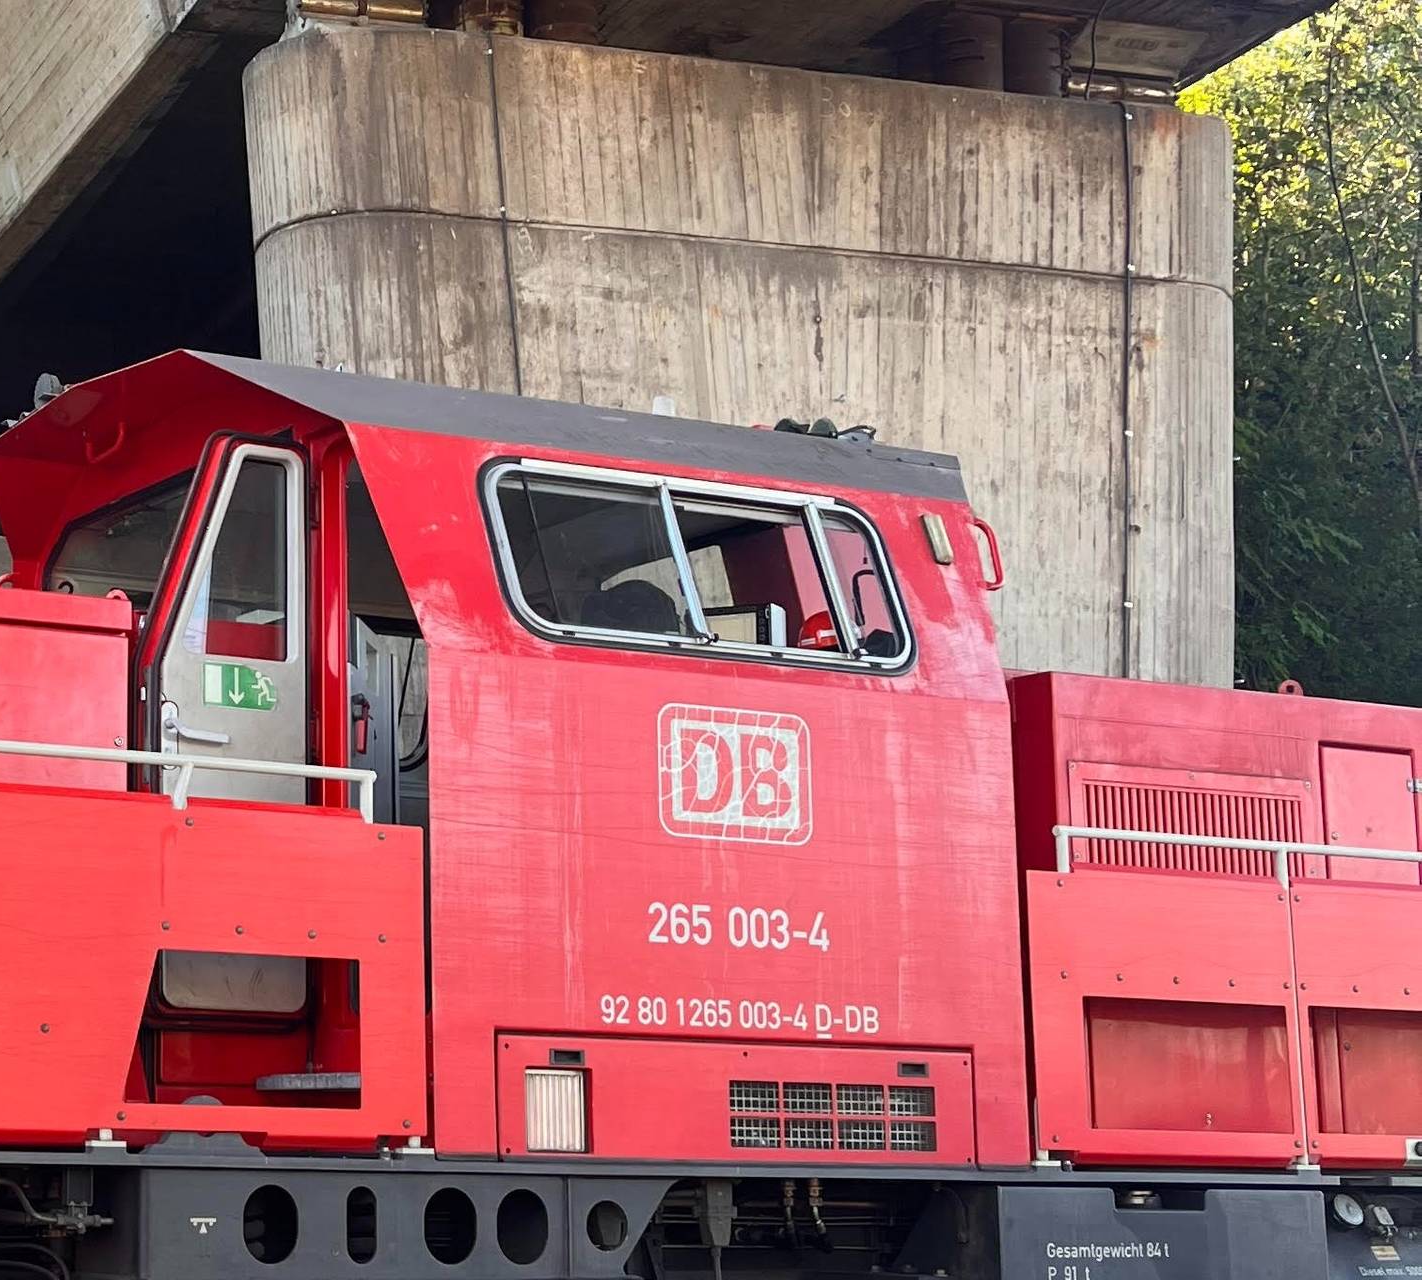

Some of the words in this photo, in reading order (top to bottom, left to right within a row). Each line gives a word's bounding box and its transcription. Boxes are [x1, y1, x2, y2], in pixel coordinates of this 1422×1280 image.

[675, 721, 797, 827] DB
[647, 901, 713, 946] 265
[728, 906, 830, 952] 003-4
[600, 994, 630, 1024] 92
[637, 996, 667, 1025] 80
[676, 997, 732, 1028] 1265
[739, 1000, 808, 1031] 003-4
[814, 1003, 880, 1039] D-DB
[1046, 1242, 1144, 1262] Gesamtgewicht
[1146, 1242, 1162, 1258] 84
[1164, 1243, 1170, 1258] t
[1047, 1266, 1058, 1280] P
[1064, 1266, 1077, 1280] 91
